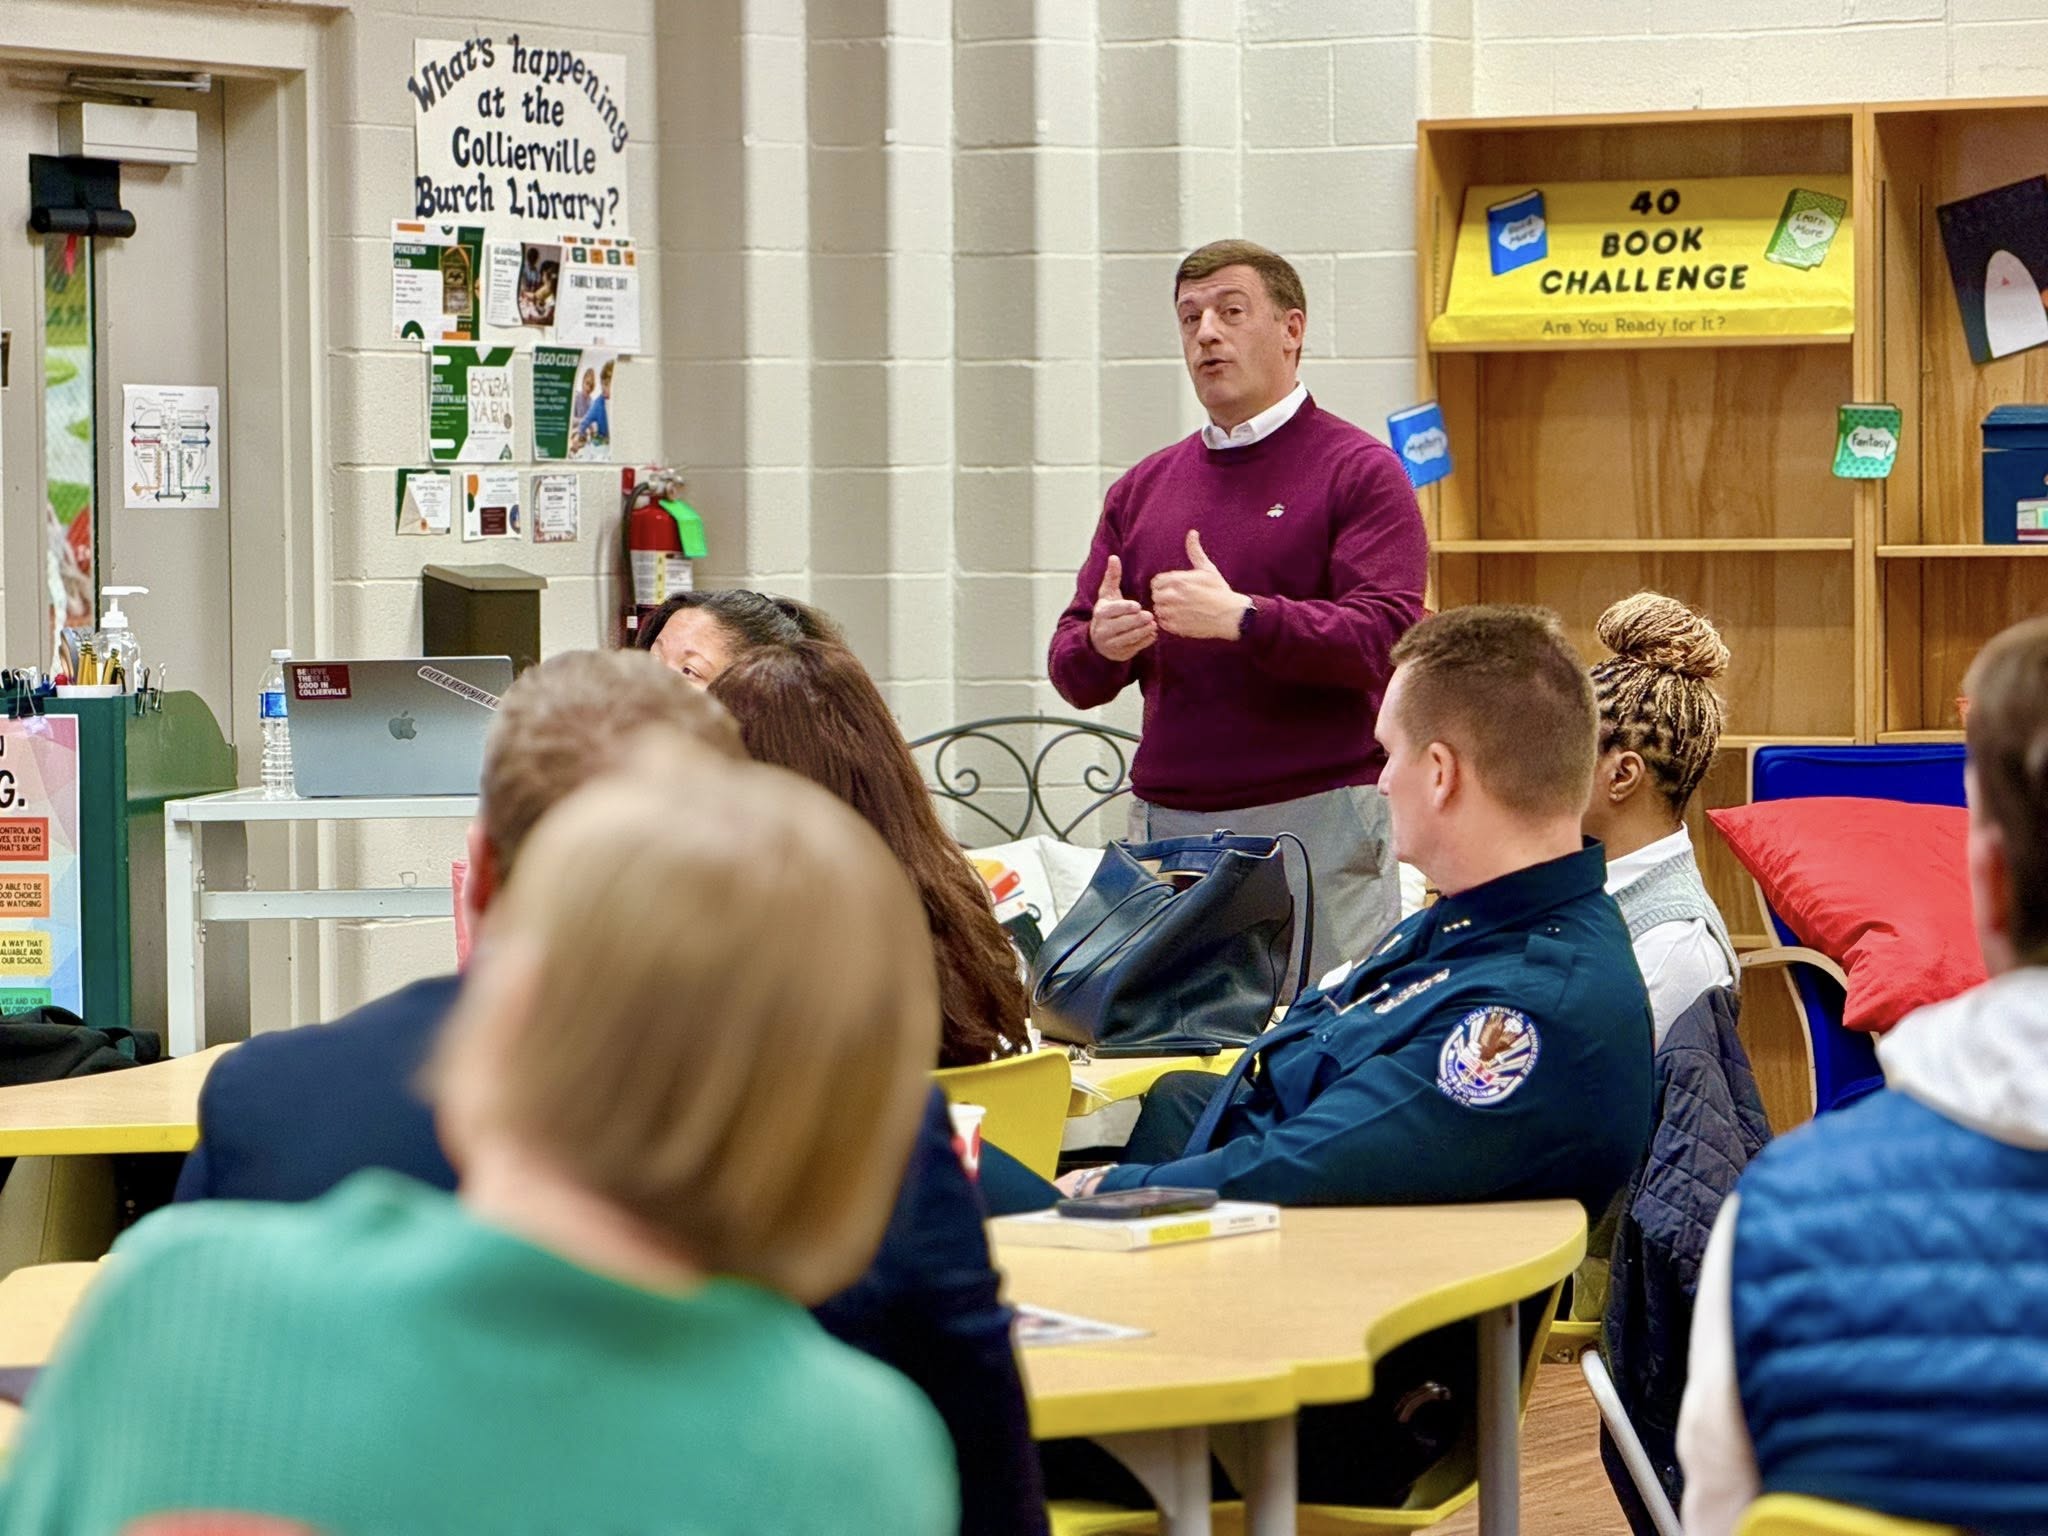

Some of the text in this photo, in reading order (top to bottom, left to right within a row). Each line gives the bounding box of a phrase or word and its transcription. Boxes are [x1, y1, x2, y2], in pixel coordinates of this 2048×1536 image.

[407, 33, 629, 153] What's happening
[478, 85, 565, 127] at the
[452, 126, 597, 175] Collierville
[415, 172, 620, 229] Burch Library?
[1629, 188, 1681, 215] 40
[1796, 212, 1827, 226] Learn
[1793, 224, 1824, 238] More
[1601, 226, 1704, 259] BOOK
[595, 276, 614, 290] MOVIE
[1540, 264, 1749, 295] CHALLENGE
[1542, 320, 1572, 335] Are
[1578, 319, 1608, 334] You
[1615, 317, 1666, 336] Ready
[1672, 316, 1696, 332] for
[533, 352, 580, 367] LEGO CLUB
[1852, 432, 1891, 457] Fantasy
[298, 681, 329, 689] GOOD IN
[299, 687, 347, 697] COLLIERVILLE
[27, 826, 41, 834] AND
[13, 835, 30, 843] STAY
[31, 835, 41, 843] ON
[0, 843, 41, 851] HAT'S RIGHT
[5, 882, 21, 891] ABLE
[23, 882, 32, 891] TO
[33, 882, 42, 891] BE
[14, 891, 42, 899] CHOICES
[6, 900, 42, 908] WATCHING
[26, 939, 42, 947] THAT
[29, 948, 43, 956] AND
[1, 957, 43, 965] OUR SCHOOL
[1464, 1006, 1524, 1025] COLLIERVILLE
[1521, 1023, 1539, 1075] TENNESSEE
[1439, 1080, 1468, 1105] POLICE
